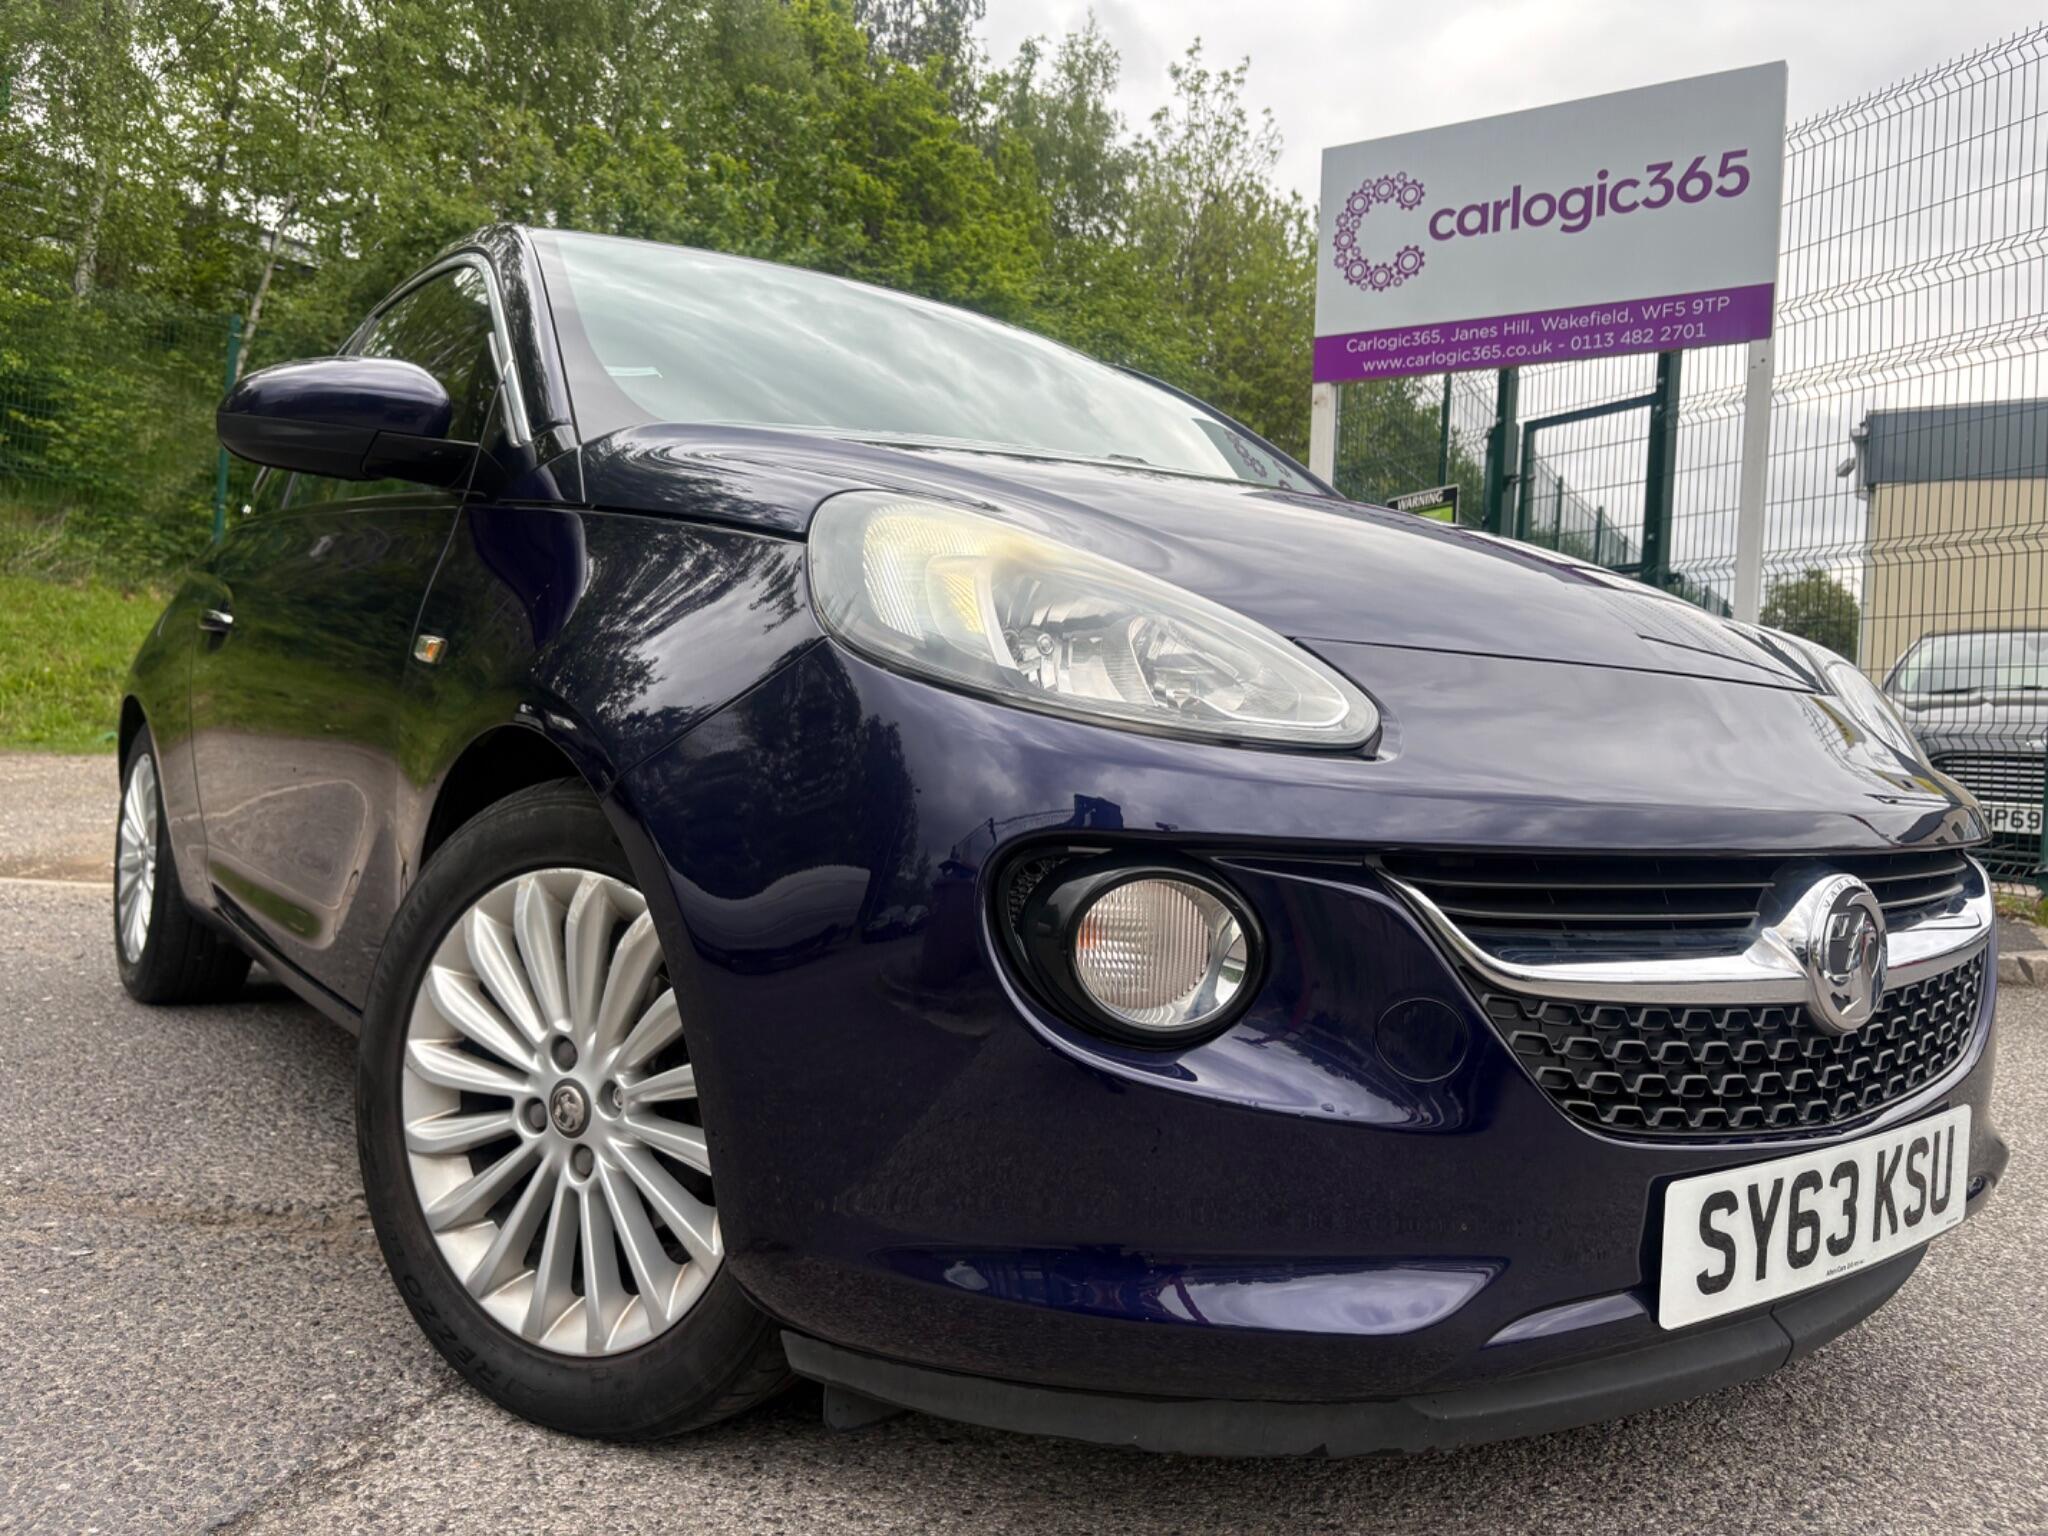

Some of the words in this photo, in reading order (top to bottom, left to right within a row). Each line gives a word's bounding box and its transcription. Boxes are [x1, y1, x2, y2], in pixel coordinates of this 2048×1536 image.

[1429, 148, 1751, 242] carlogic365
[1346, 329, 1445, 353] Carlogic365,
[1451, 325, 1498, 342] Janes
[1504, 319, 1535, 337] Hill,
[1541, 308, 1634, 331] Wakefield,
[1642, 301, 1686, 321] WF5
[1692, 296, 1730, 314] 9TP
[1363, 339, 1552, 372] www.carlogic365.co.uk
[1571, 332, 1614, 350] 0113
[1620, 328, 1654, 346] 482
[1660, 322, 1706, 341] 2701
[1397, 491, 1444, 512] WARNING
[1696, 1159, 1860, 1296] SY63
[1872, 1125, 1955, 1243] KSU
